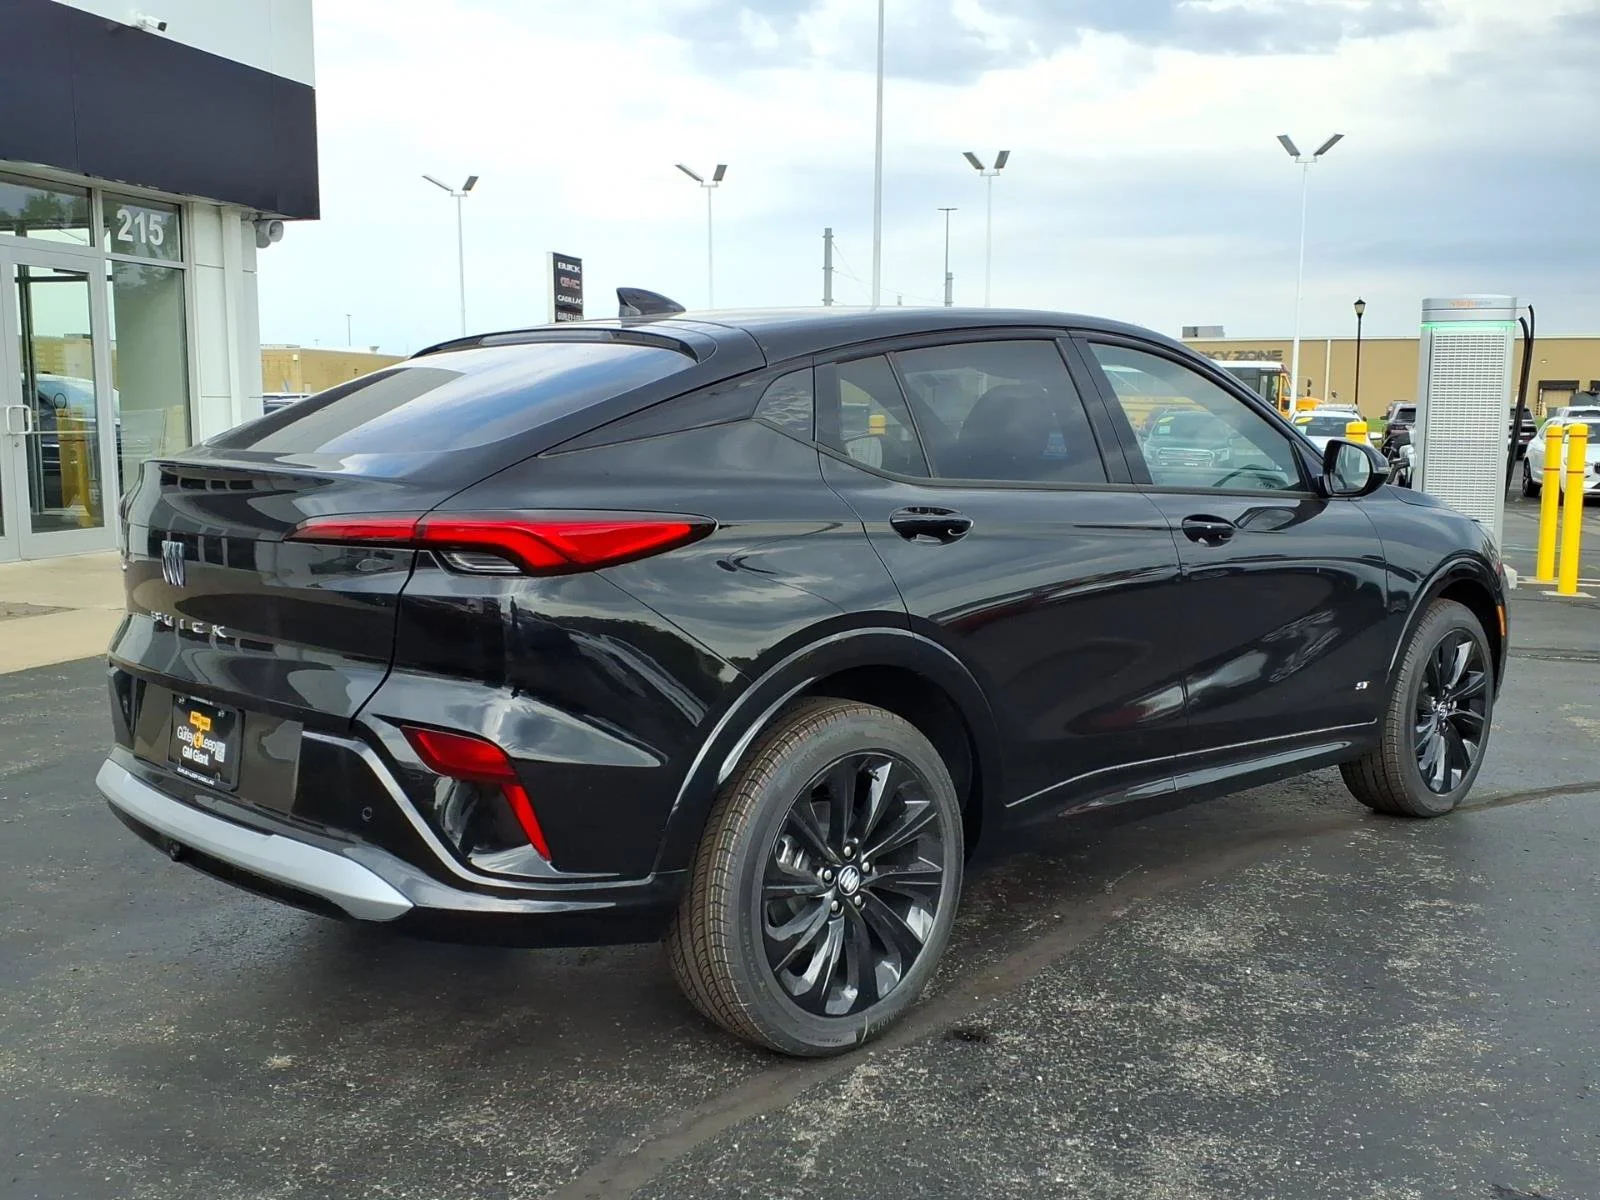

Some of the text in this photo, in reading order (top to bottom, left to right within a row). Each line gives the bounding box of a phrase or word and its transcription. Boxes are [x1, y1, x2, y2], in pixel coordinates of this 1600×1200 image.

[117, 209, 164, 246] 215
[558, 262, 581, 273] BUICK
[558, 294, 583, 304] CADILLAC
[1233, 349, 1283, 361] ZONE
